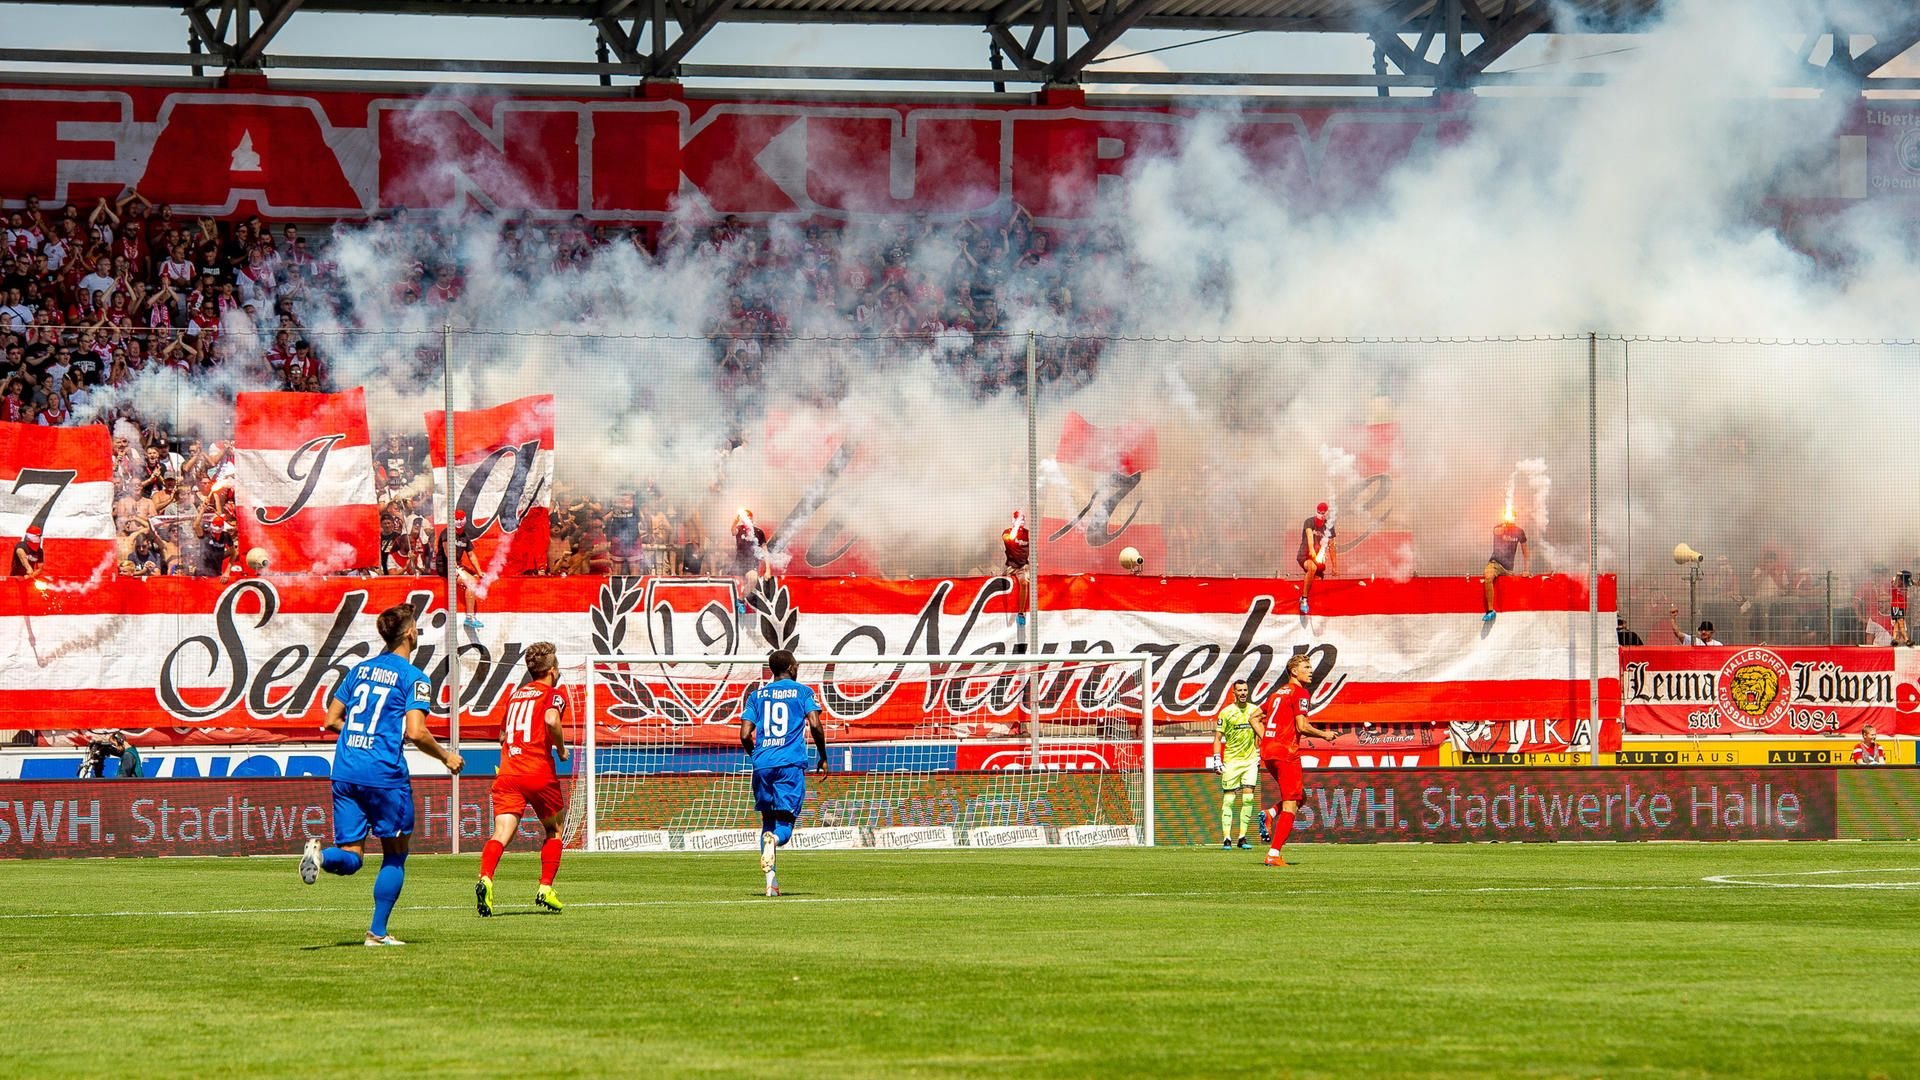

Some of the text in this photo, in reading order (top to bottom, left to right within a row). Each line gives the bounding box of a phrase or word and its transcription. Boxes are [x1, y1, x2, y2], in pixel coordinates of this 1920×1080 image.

[820, 576, 1349, 721] Neunzehn
[1723, 650, 1786, 678] HALLESCHER
[1626, 661, 1893, 704] Leuna Löwen
[347, 683, 391, 735] 27
[505, 699, 536, 744] 44
[763, 700, 789, 738] 19
[1267, 696, 1282, 729] 2
[1688, 708, 1840, 730] seit 1984
[1719, 686, 1784, 727] FUSSBALLCLUB
[1772, 752, 1886, 763] AUTOH
[131, 796, 336, 843] Stadtwe
[425, 796, 540, 838] Hale
[1422, 784, 1672, 829] Stadtwerke
[1691, 783, 1800, 828] Halle
